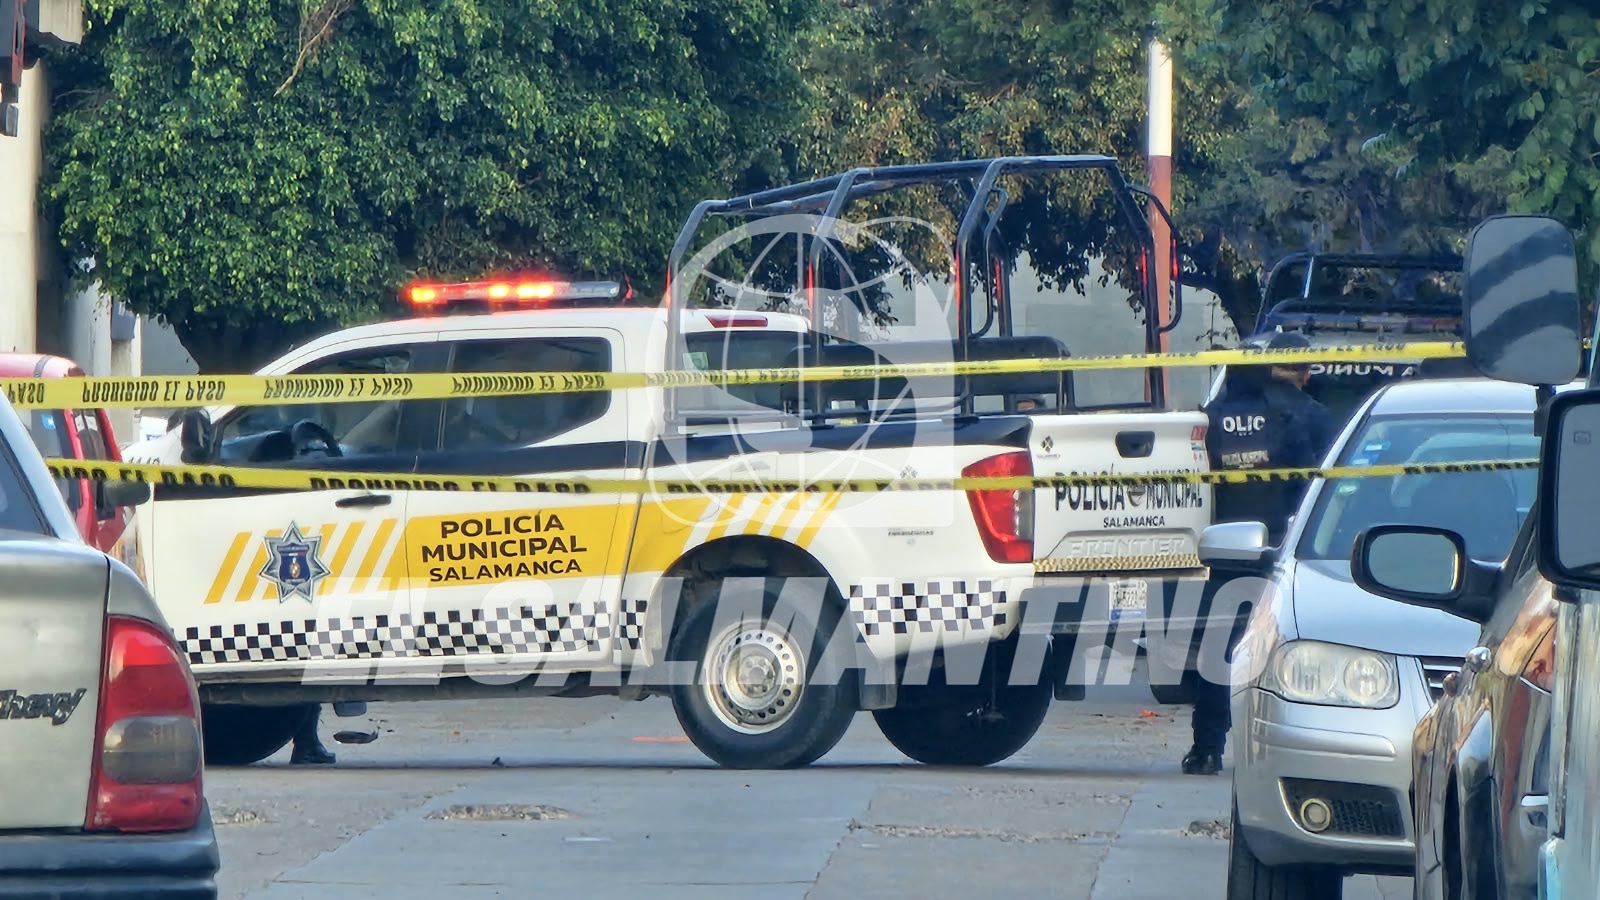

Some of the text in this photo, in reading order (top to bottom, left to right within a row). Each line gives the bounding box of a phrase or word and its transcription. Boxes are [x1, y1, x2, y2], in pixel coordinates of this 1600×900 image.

[441, 510, 565, 539] POLICÍA
[1103, 516, 1165, 528] SALAMANCA
[421, 536, 587, 563] MUNICIPAL
[429, 559, 582, 582] SALAMANCA
